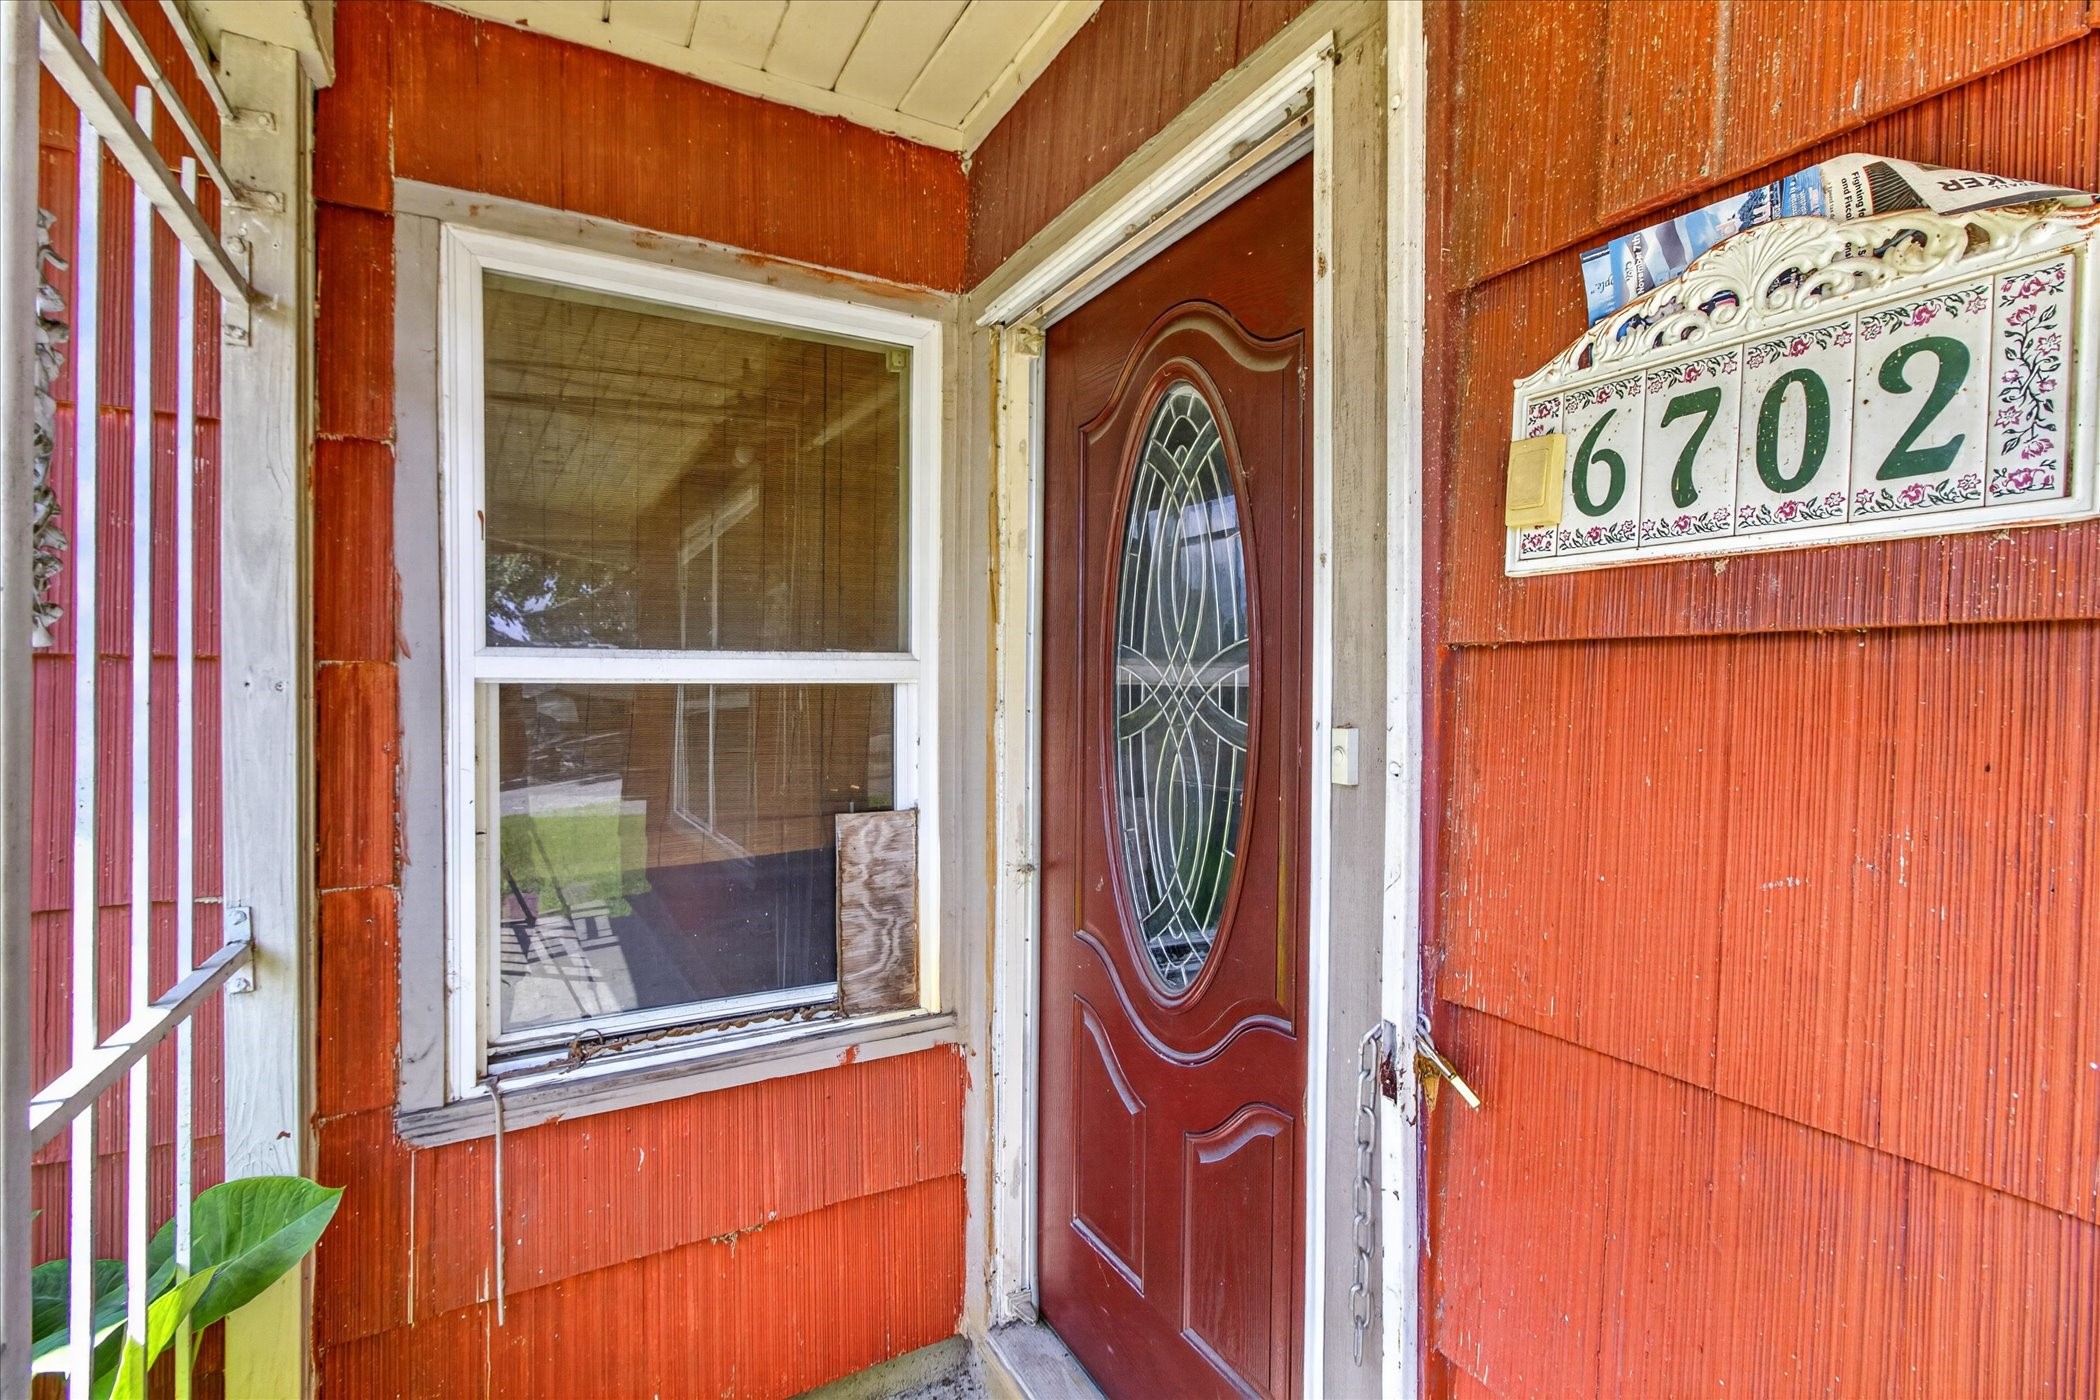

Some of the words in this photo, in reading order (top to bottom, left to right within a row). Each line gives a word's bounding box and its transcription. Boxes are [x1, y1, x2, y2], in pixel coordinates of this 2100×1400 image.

[1841, 178, 1850, 195] and
[1850, 171, 1864, 208] Fighting
[1631, 234, 1642, 252] 7th
[1635, 252, 1646, 295] November
[1572, 335, 1970, 516] 6702
